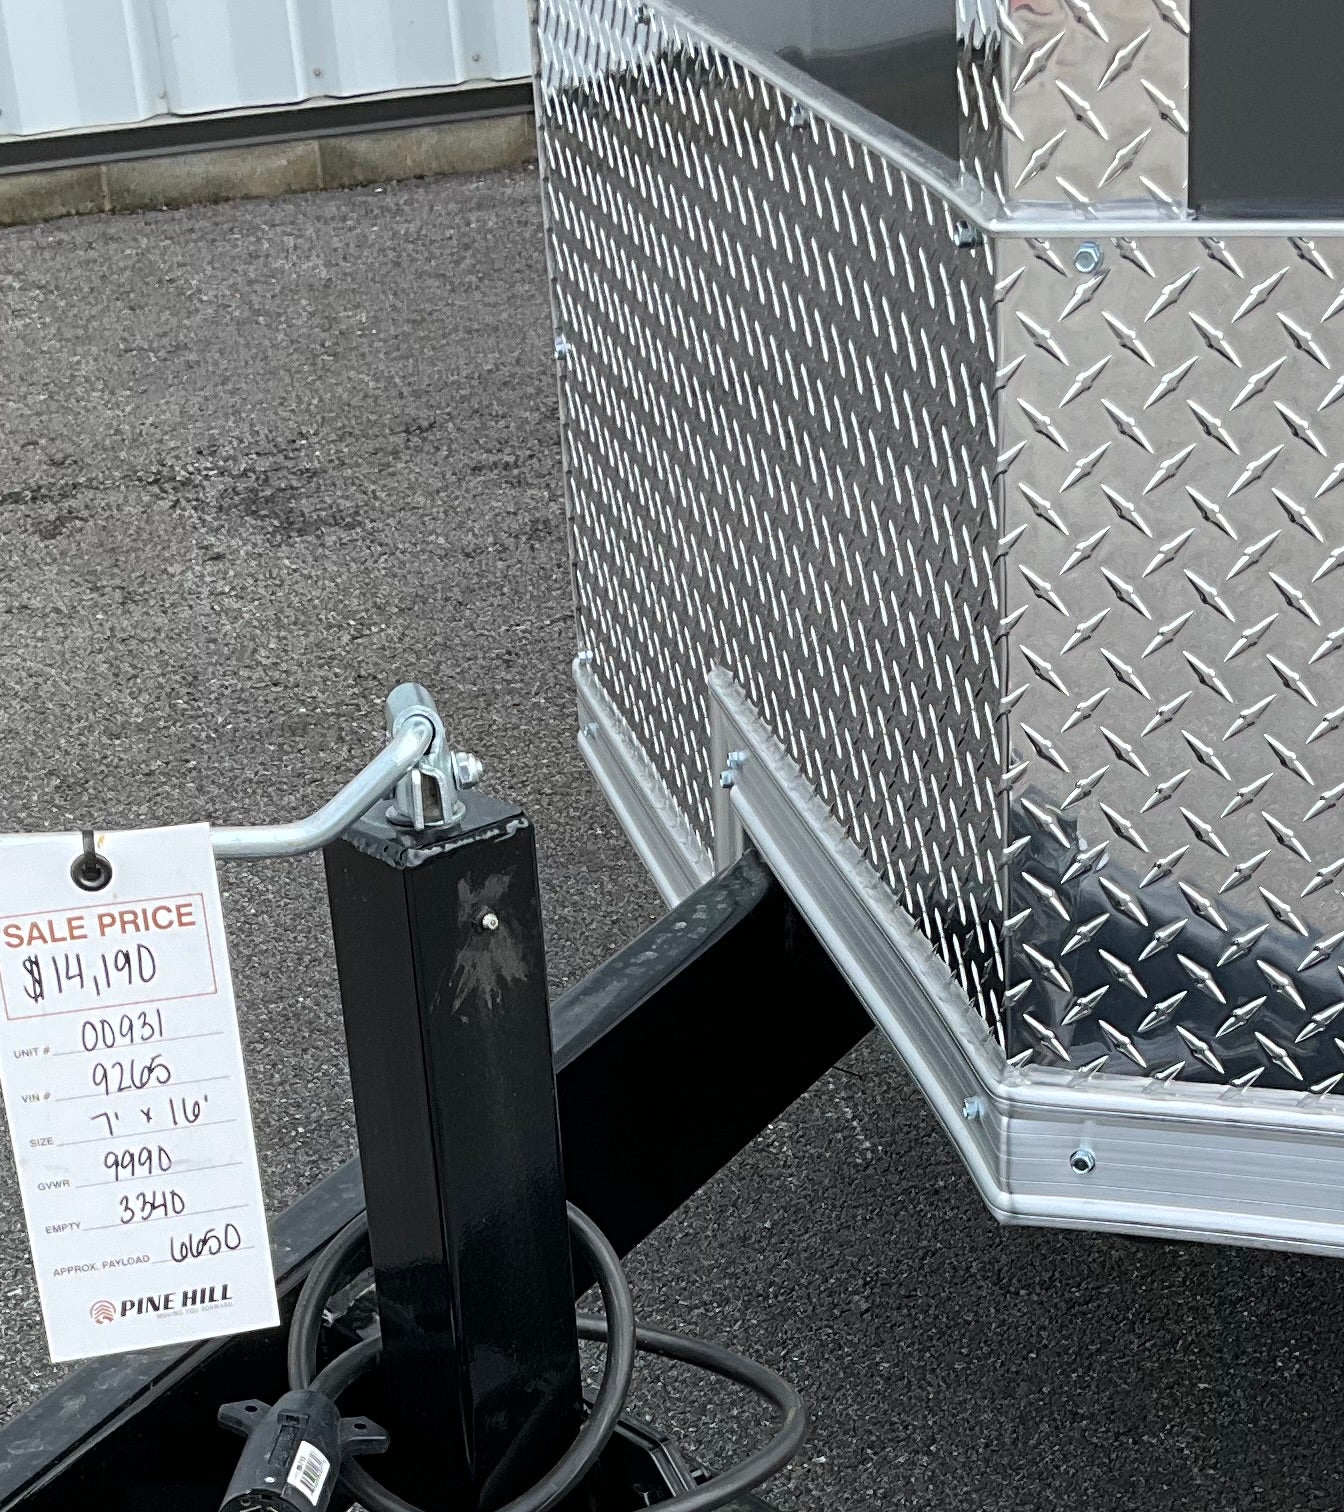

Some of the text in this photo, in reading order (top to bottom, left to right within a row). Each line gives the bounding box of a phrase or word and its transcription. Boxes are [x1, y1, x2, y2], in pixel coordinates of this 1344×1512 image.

[2, 903, 197, 949] SALE PRICE
[23, 944, 157, 1003] $14,190
[13, 1047, 40, 1060] UNIT
[42, 1045, 51, 1056] #
[21, 1054, 172, 1104] VIN # 9265
[30, 1137, 54, 1149] SIZE
[38, 1145, 173, 1191] GVWR 9990
[45, 1190, 186, 1235] EMPTY 3340
[53, 1223, 242, 1277] APPROX. PAYLOAD 6650
[120, 1283, 234, 1318] PINE HILL
